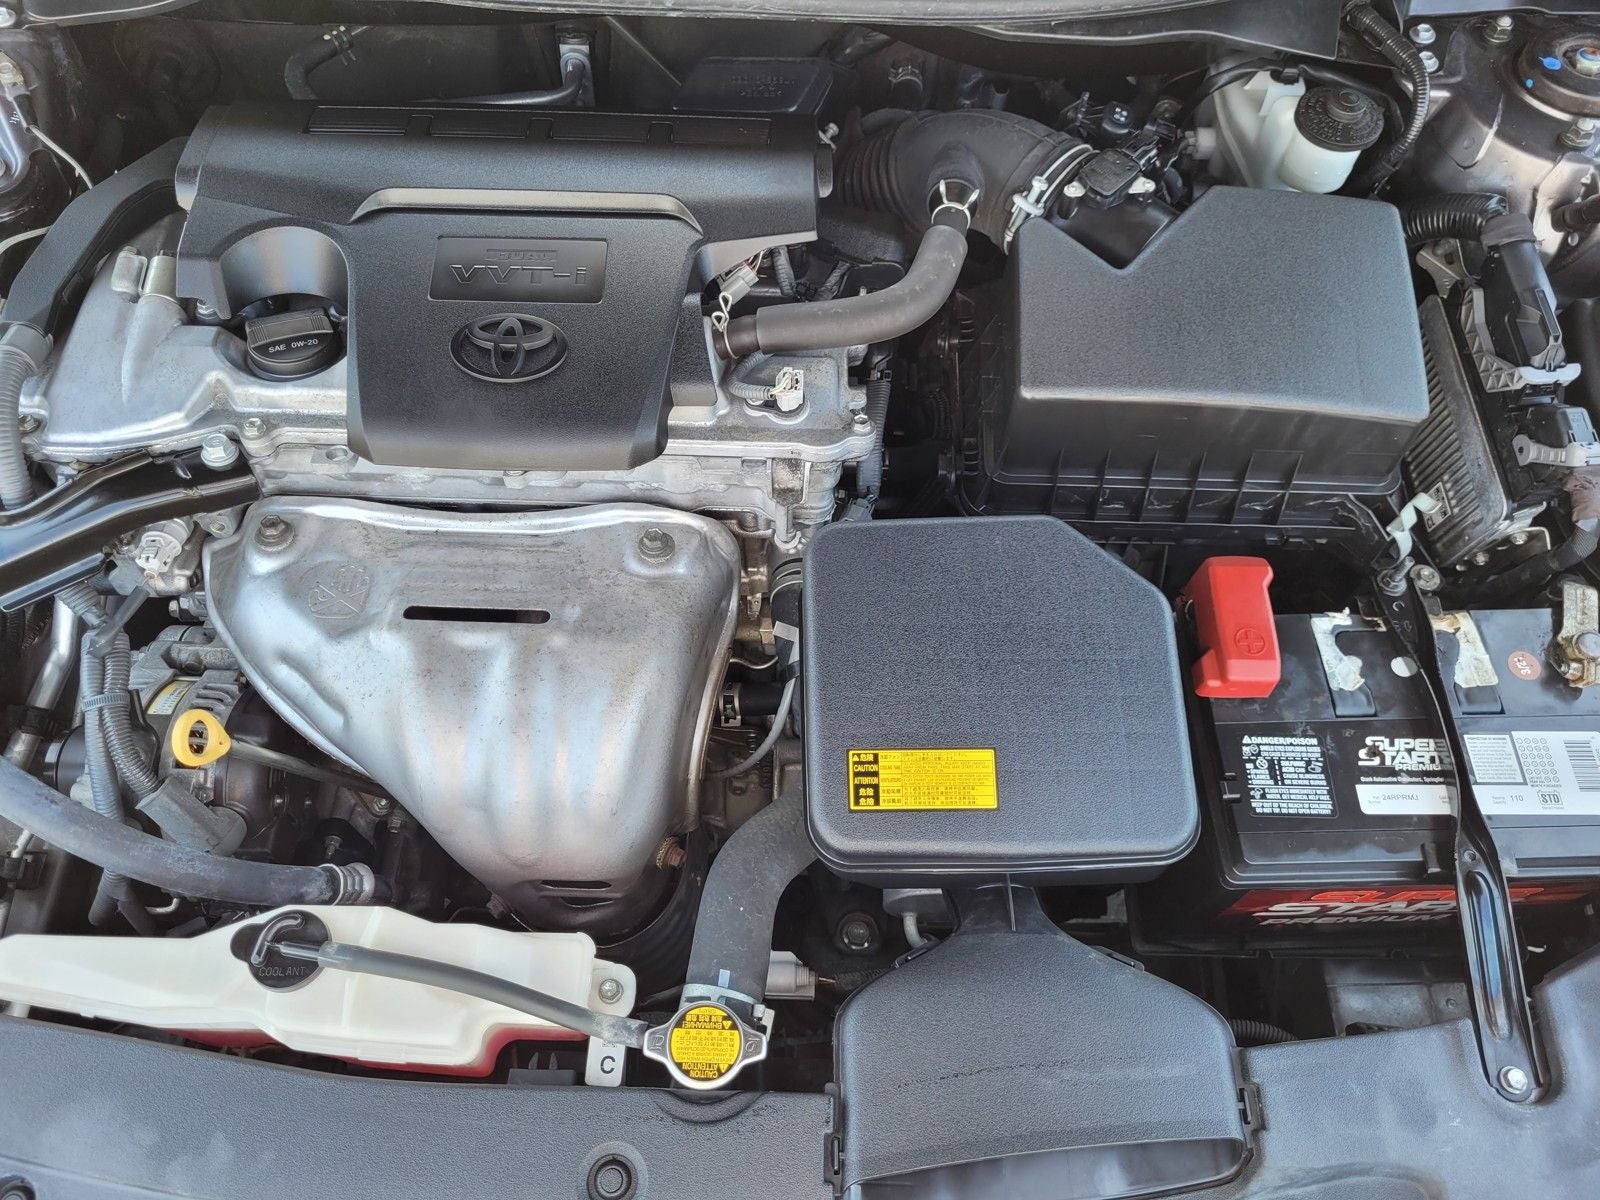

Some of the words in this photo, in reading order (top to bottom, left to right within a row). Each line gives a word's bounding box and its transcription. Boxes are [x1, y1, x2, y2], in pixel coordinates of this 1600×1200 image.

[450, 264, 586, 285] VVT-i
[268, 343, 287, 353] SAE
[291, 338, 319, 349] 0W-20
[1250, 736, 1318, 745] DANGER/POISON
[1365, 736, 1448, 751] SUPER
[1358, 748, 1450, 766] START
[854, 764, 879, 772] CAUTION
[854, 776, 879, 785] ATTENTION
[1541, 793, 1560, 803] STD
[1253, 900, 1457, 915] STAR
[1259, 913, 1453, 926] PREMIUM
[259, 966, 306, 977] COOLANT
[600, 1055, 616, 1075] C
[682, 1062, 719, 1070] ATTENTION
[690, 1070, 718, 1078] CAUTION
